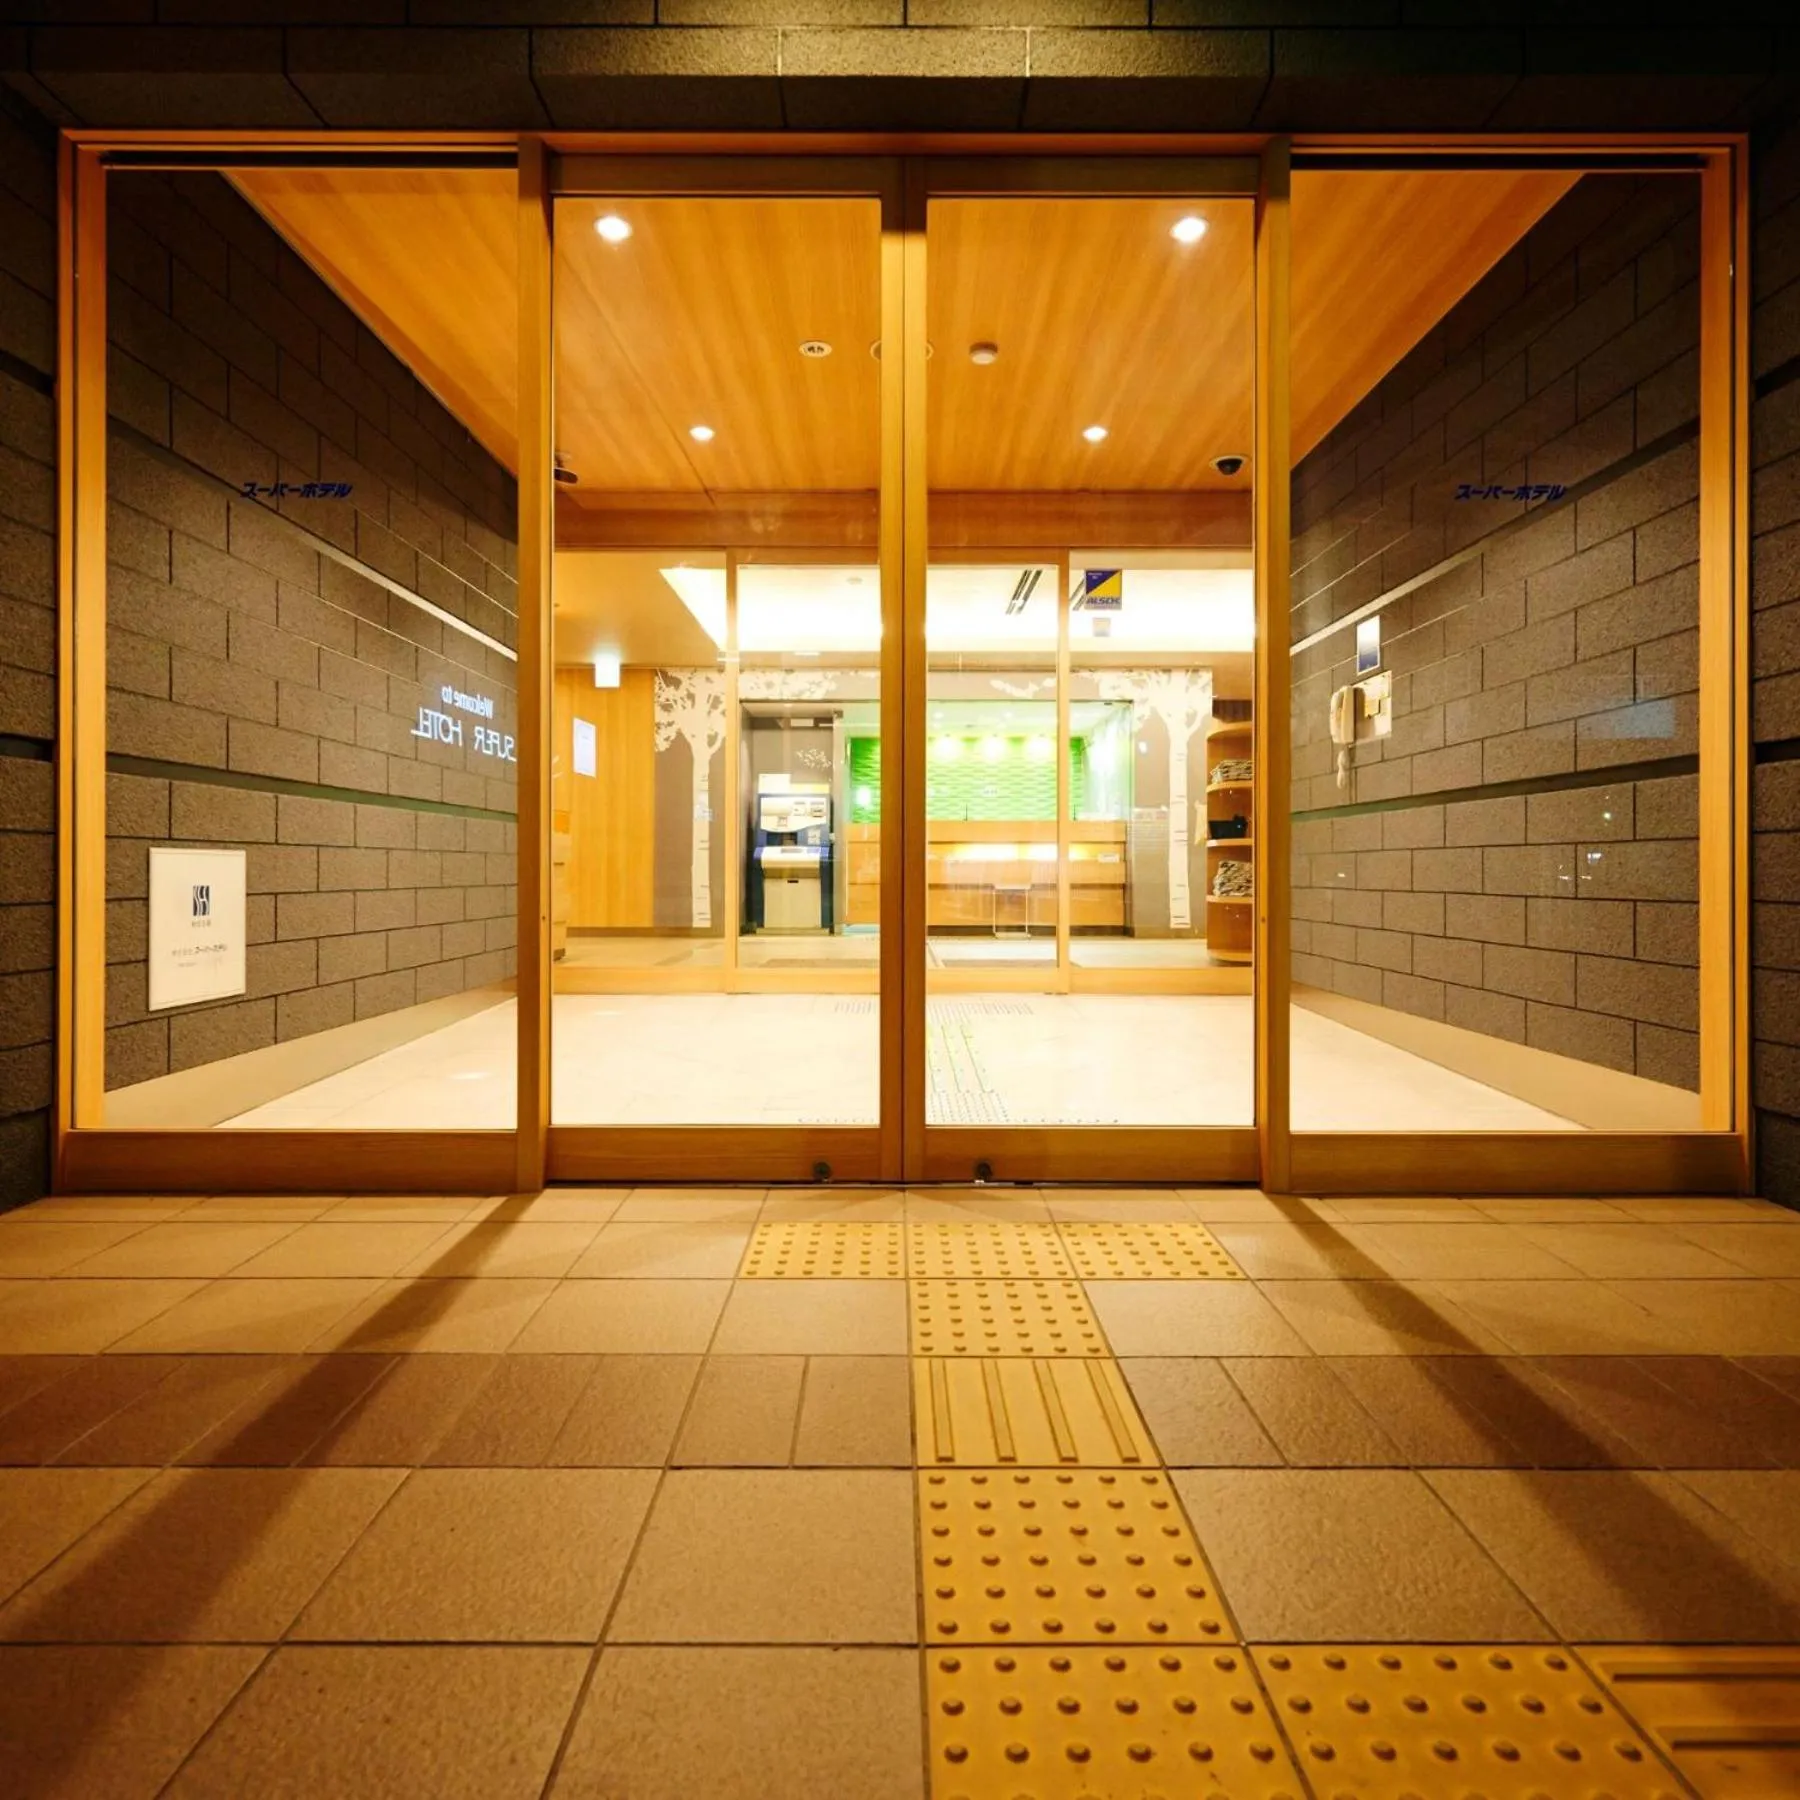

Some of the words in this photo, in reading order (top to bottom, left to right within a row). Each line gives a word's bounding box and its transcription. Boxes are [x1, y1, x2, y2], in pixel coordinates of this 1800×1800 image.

[1454, 484, 1566, 500] スーパーホテル
